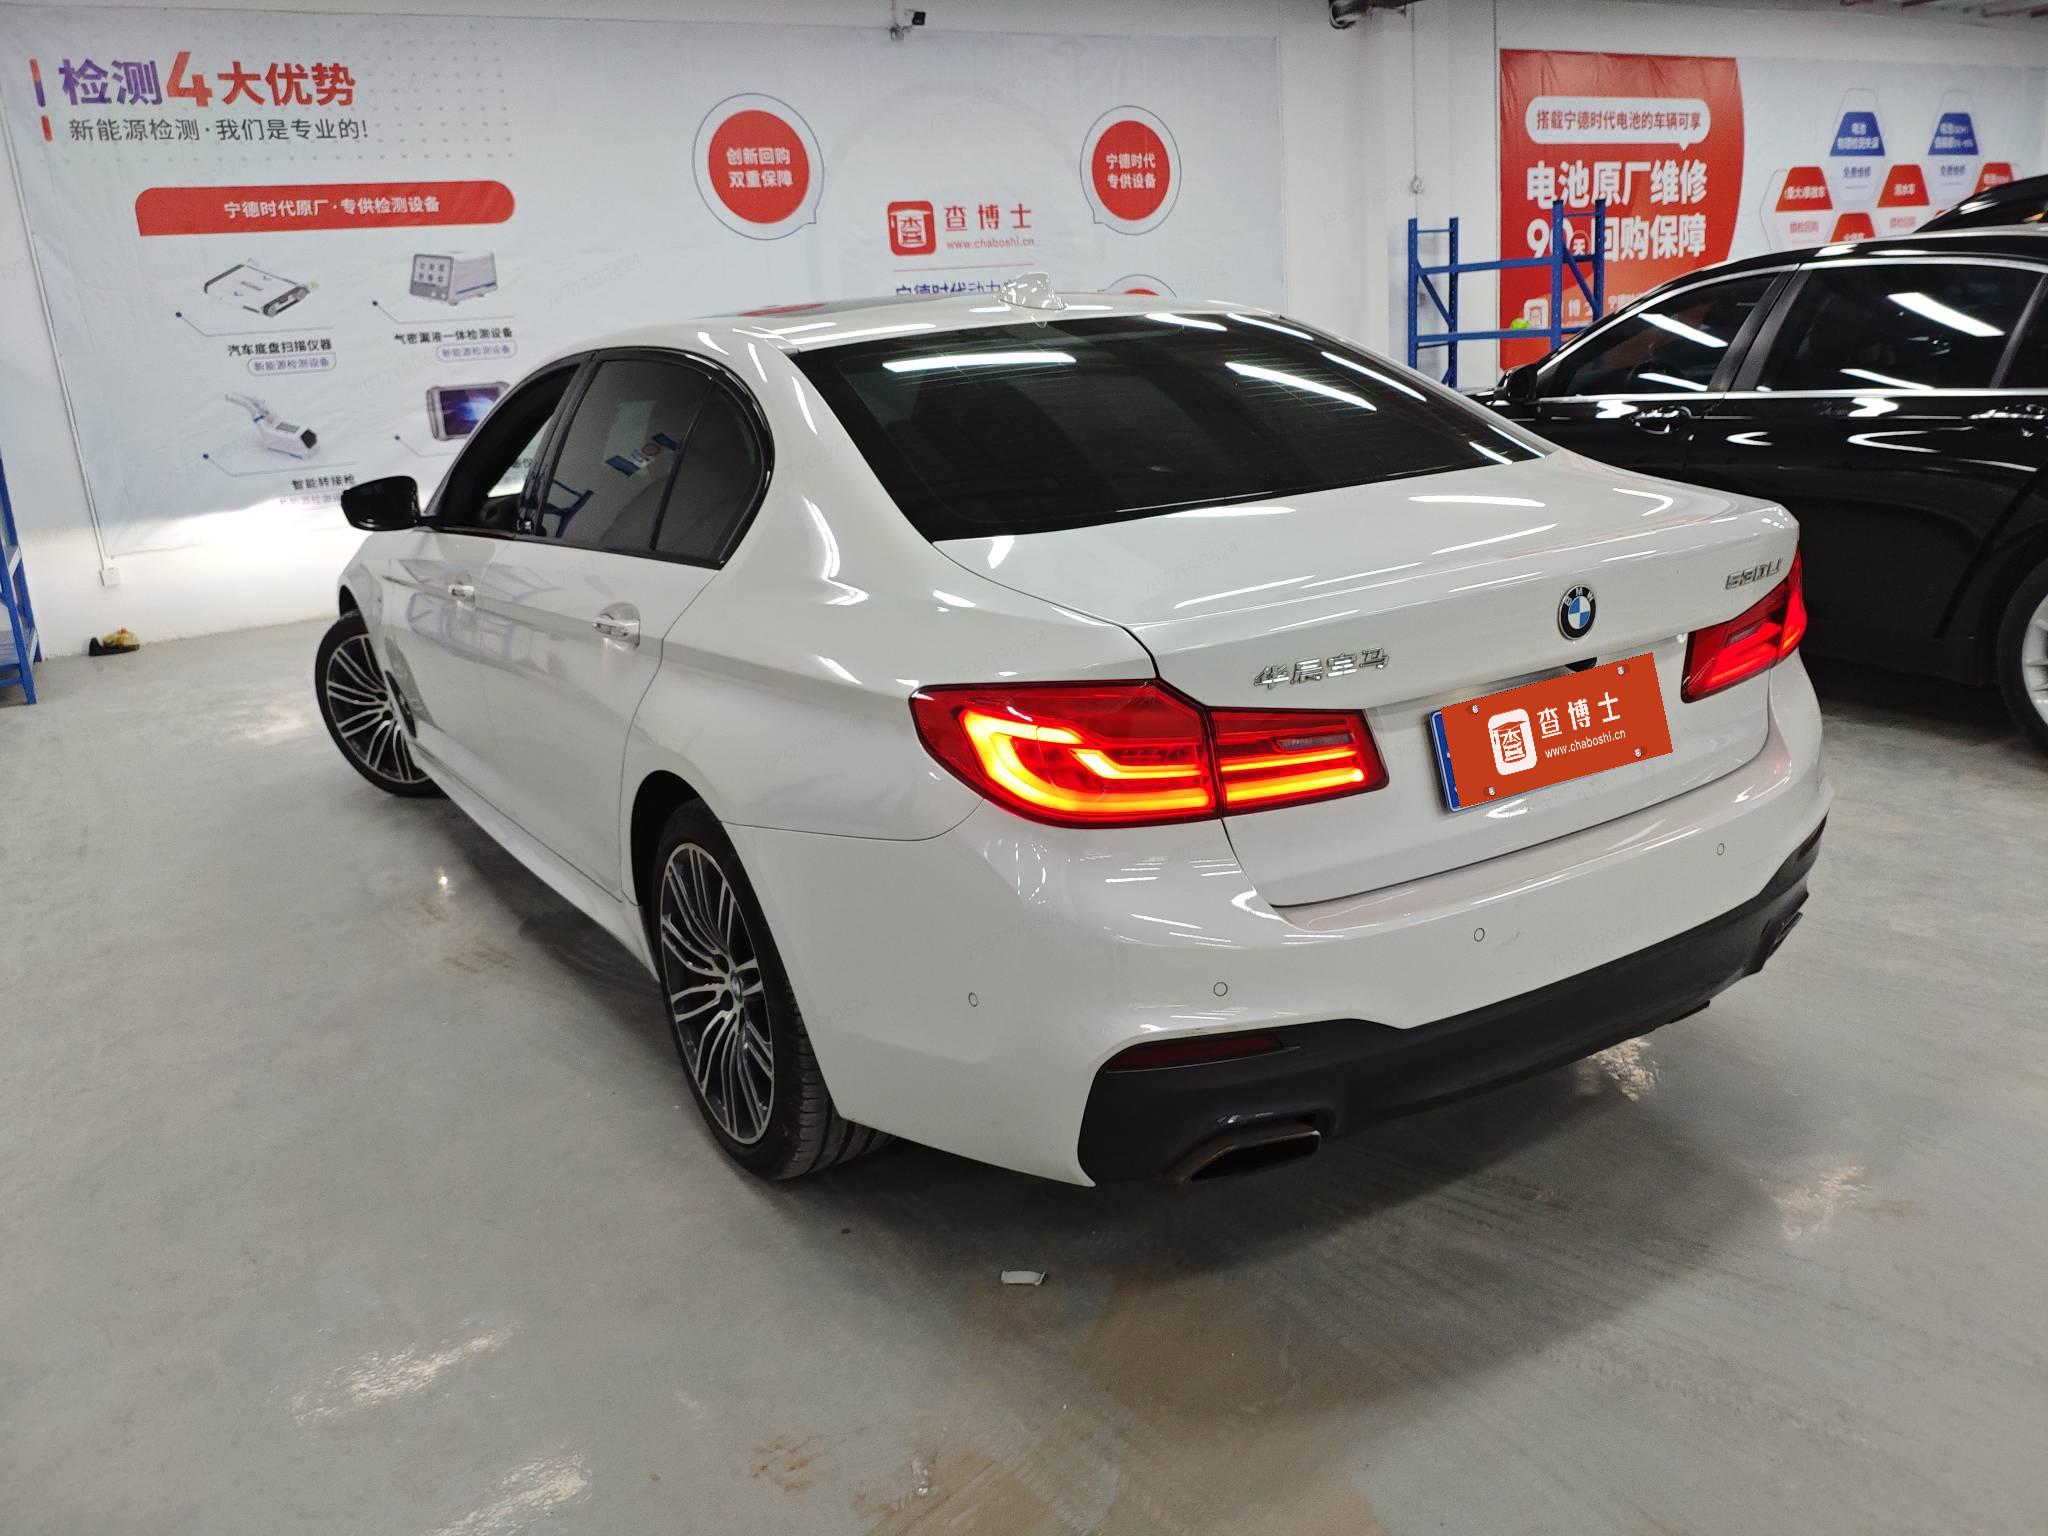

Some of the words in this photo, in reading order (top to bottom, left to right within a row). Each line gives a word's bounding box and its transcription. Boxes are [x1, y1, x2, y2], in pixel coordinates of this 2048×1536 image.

[58, 51, 356, 108] 检测4大优势
[1537, 111, 1701, 130] 搭载宁德时代电池的车辆可享
[727, 147, 791, 165] 创新回购
[1106, 152, 1156, 170] 宁德时代
[728, 170, 793, 188] 双重保障
[1107, 172, 1156, 189] 专供设备
[1526, 160, 1708, 209] 电池原厂维修
[944, 203, 1032, 232] 查博士
[946, 236, 1034, 249] www.chaboshi.cn
[1564, 587, 1594, 607] BMW
[1253, 648, 1389, 690] 华晨宝马
